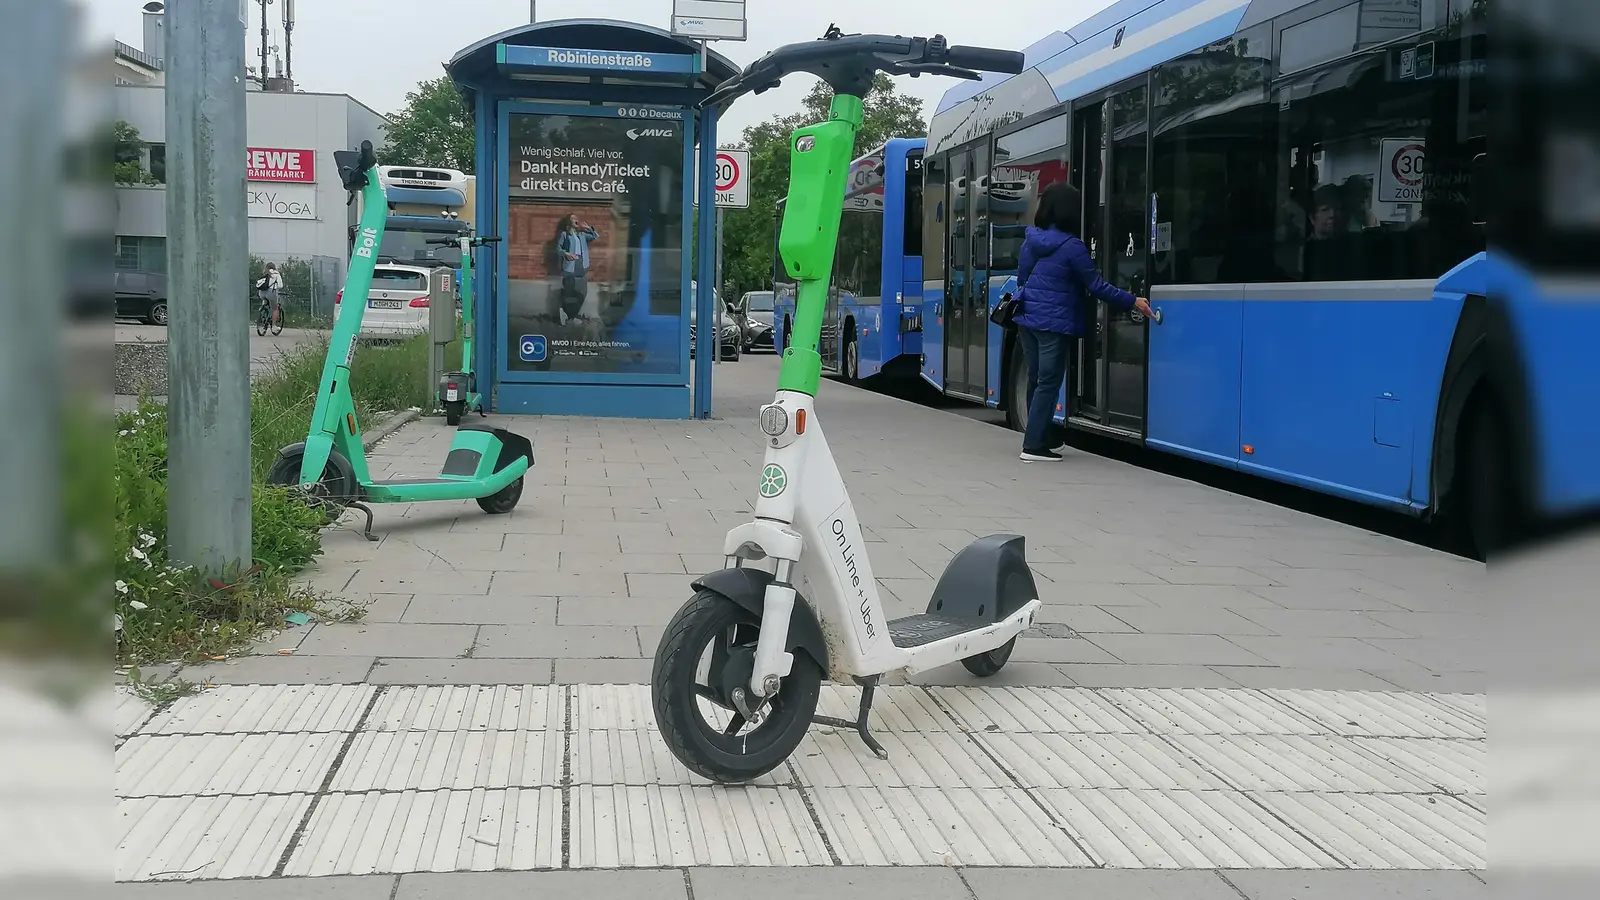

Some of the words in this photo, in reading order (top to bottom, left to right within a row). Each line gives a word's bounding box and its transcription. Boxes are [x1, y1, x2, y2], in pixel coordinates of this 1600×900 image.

[548, 49, 652, 67] Robinienstraße
[650, 109, 682, 119] Decaux
[640, 128, 673, 137] MVG
[520, 146, 552, 159] Wenig
[553, 147, 586, 158] Schlaf.
[587, 148, 605, 159] Viel
[606, 150, 624, 160] vor.
[248, 168, 305, 179] RÄNKEMARKT
[521, 160, 559, 174] Dank
[561, 161, 650, 179] HandyTicket
[1400, 155, 1424, 175] 30
[520, 177, 565, 191] direkt
[567, 178, 589, 192] ins
[591, 179, 629, 194] Café.
[356, 227, 378, 259] Bolt
[831, 518, 847, 548] On
[842, 543, 860, 588] Lime
[860, 598, 876, 640] Uber
